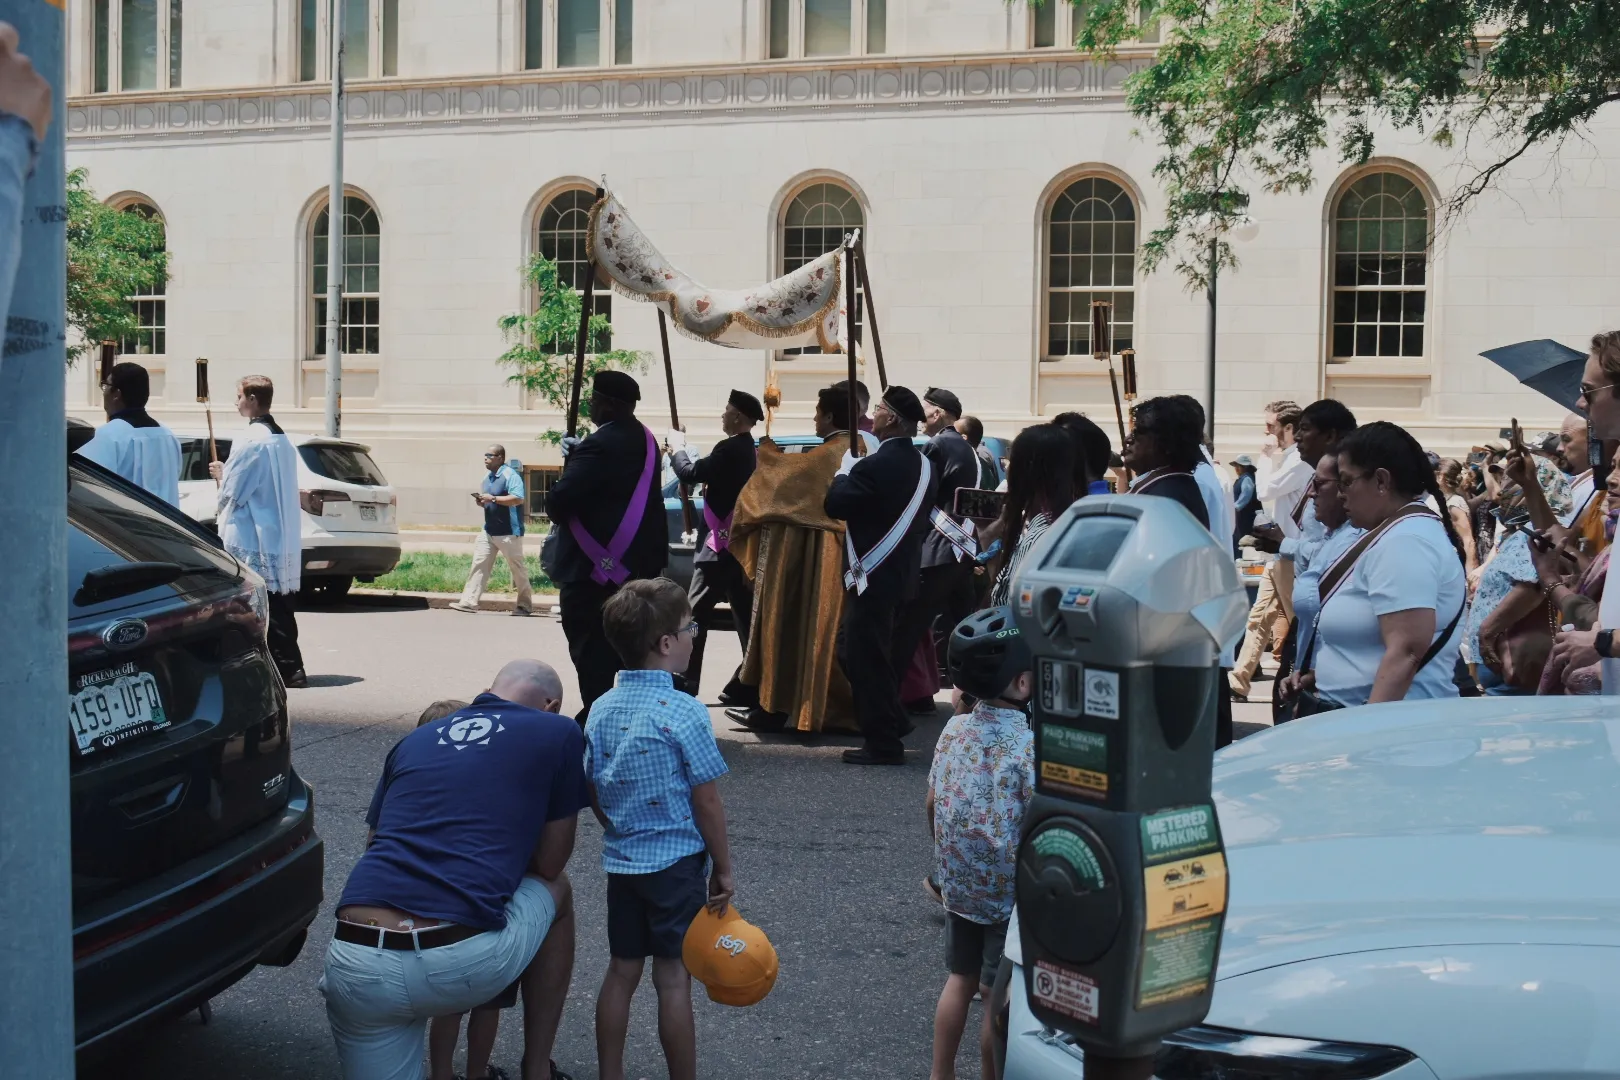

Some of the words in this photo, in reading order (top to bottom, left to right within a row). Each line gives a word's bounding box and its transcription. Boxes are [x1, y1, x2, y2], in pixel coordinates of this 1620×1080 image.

[118, 626, 141, 643] Ford
[116, 726, 148, 740] INFINITI
[1044, 726, 1063, 738] PAID
[1066, 730, 1104, 748] PARKING
[1146, 810, 1208, 836] METERED
[1150, 825, 1208, 850] PARKING
[1054, 994, 1093, 1012] WEDNESDAY
